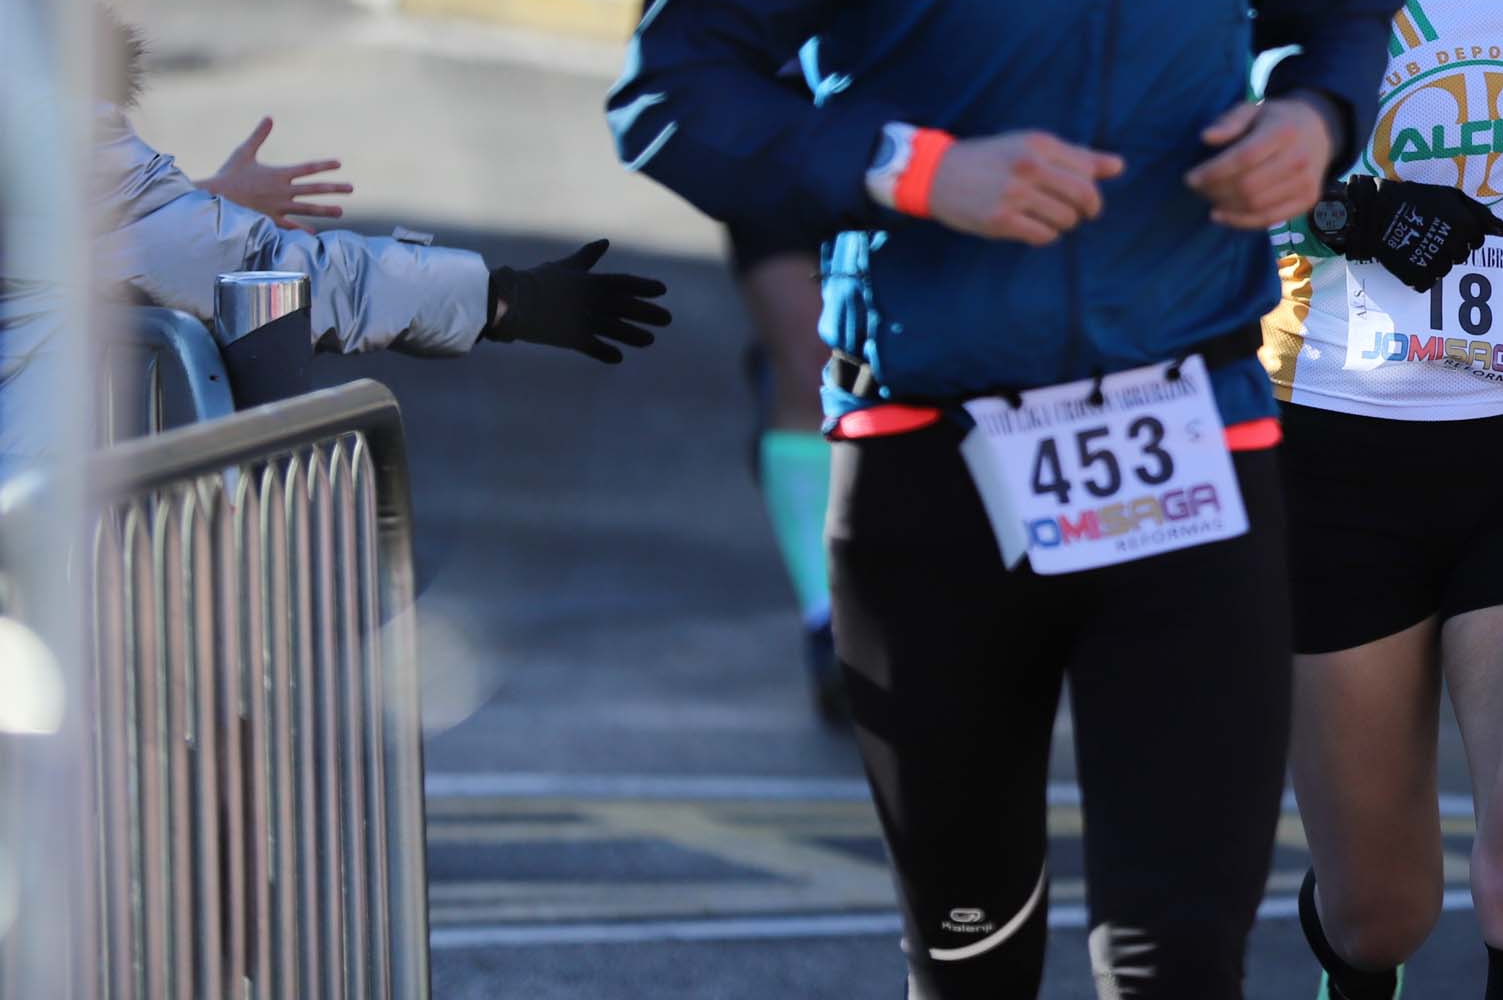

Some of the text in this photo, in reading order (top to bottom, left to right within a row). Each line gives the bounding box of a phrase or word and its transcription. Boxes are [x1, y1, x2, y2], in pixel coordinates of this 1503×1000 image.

[1388, 222, 1408, 249] 2018
[1417, 222, 1452, 266] MEDIA
[1430, 272, 1493, 336] 18
[1030, 415, 1175, 505] 453
[1115, 519, 1225, 551] REFORMAS
